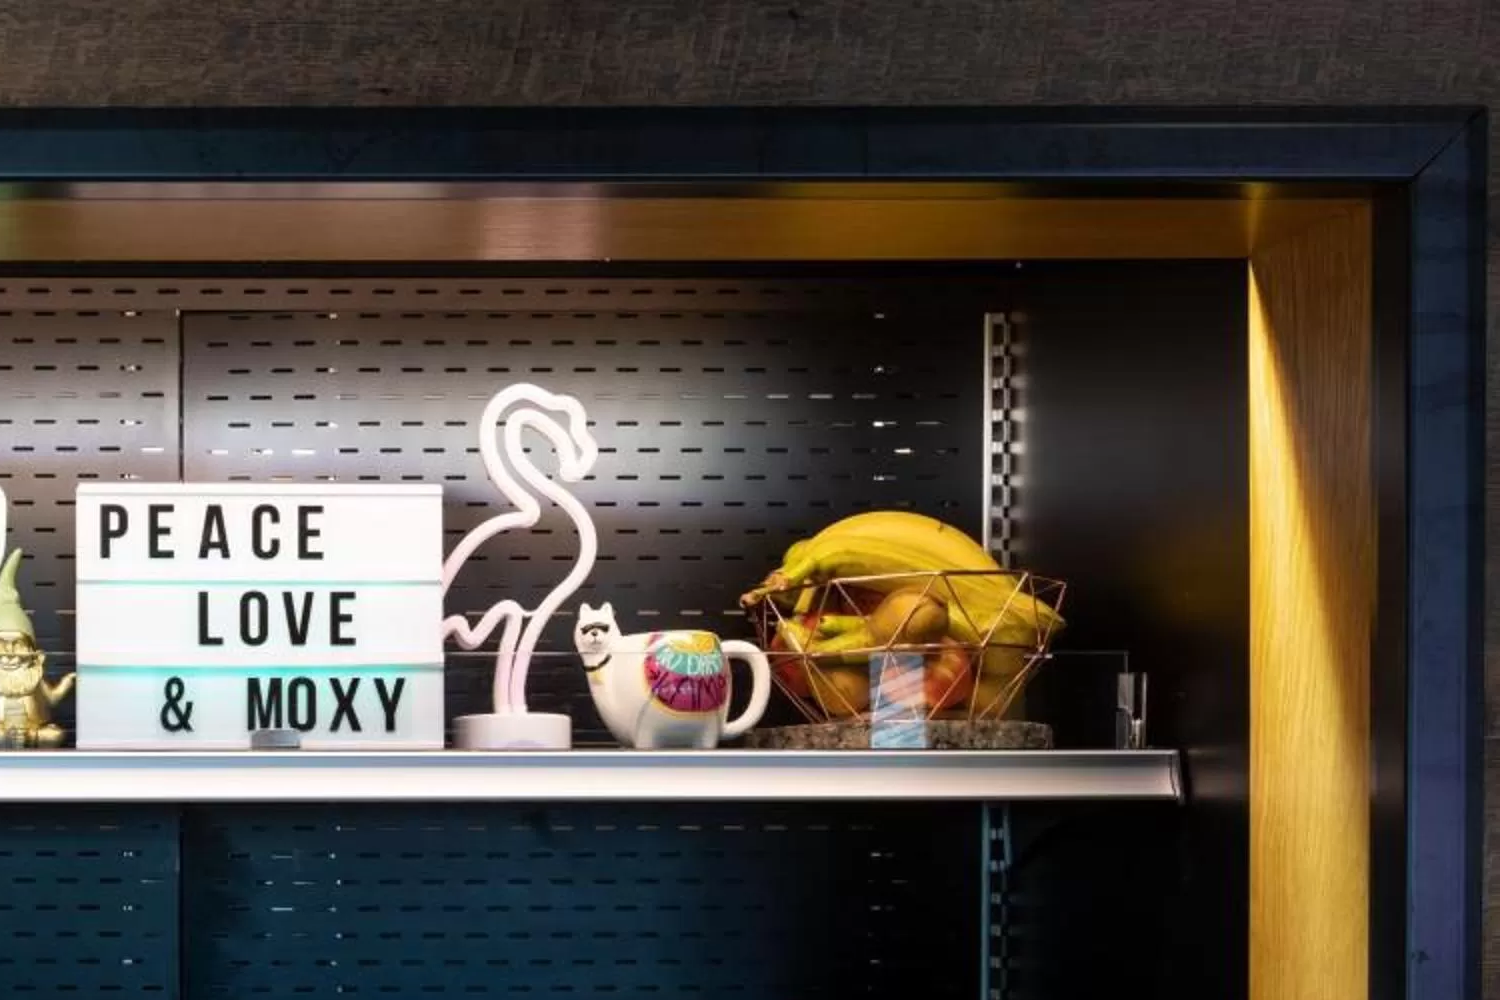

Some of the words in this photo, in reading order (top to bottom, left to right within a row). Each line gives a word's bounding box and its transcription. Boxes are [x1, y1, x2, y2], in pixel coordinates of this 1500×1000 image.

[99, 504, 324, 560] PEACE
[197, 591, 357, 646] LOVE
[160, 677, 194, 733] &
[246, 677, 406, 732] MOXY
